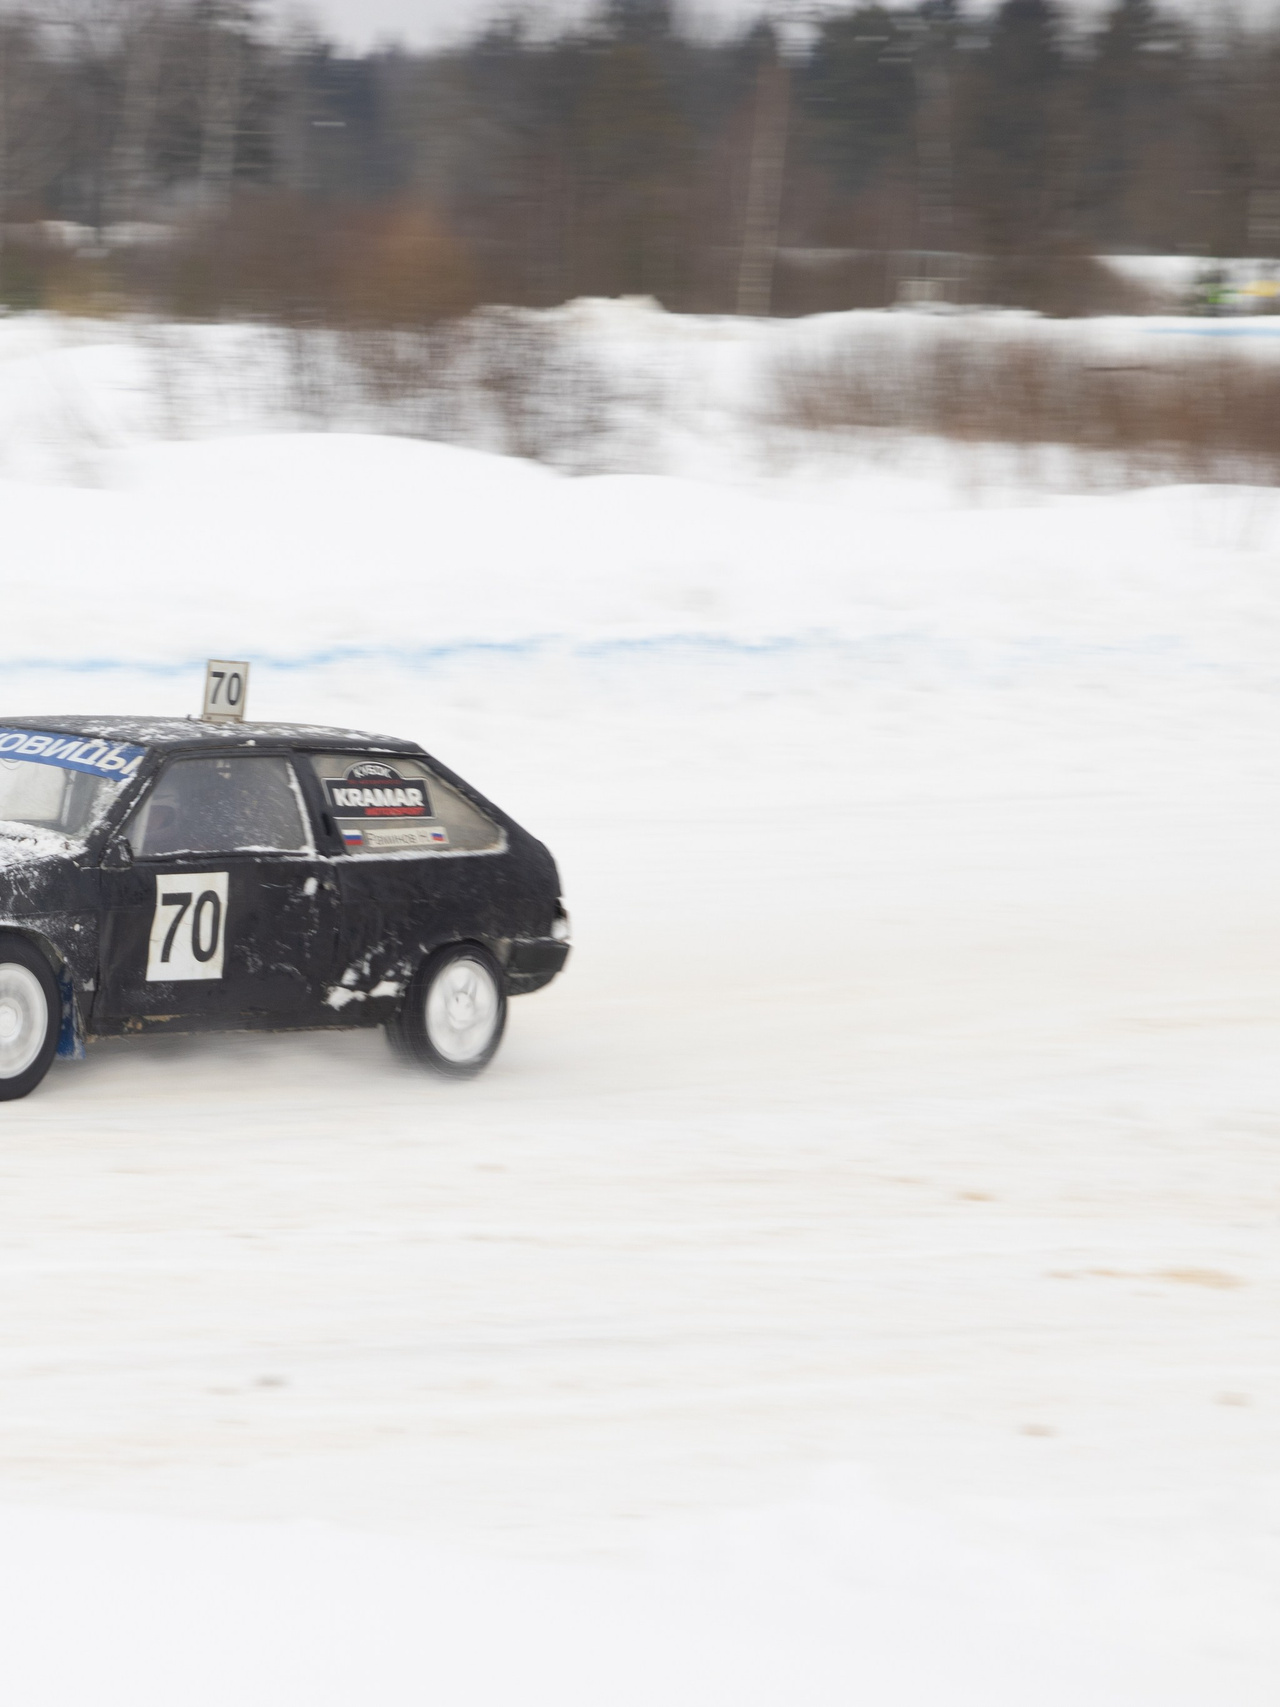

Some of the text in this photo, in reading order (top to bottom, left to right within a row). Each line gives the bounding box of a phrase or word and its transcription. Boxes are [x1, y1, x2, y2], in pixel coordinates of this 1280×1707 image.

[211, 671, 242, 706] 70
[332, 788, 425, 807] KRAMAR
[160, 889, 222, 963] 70
